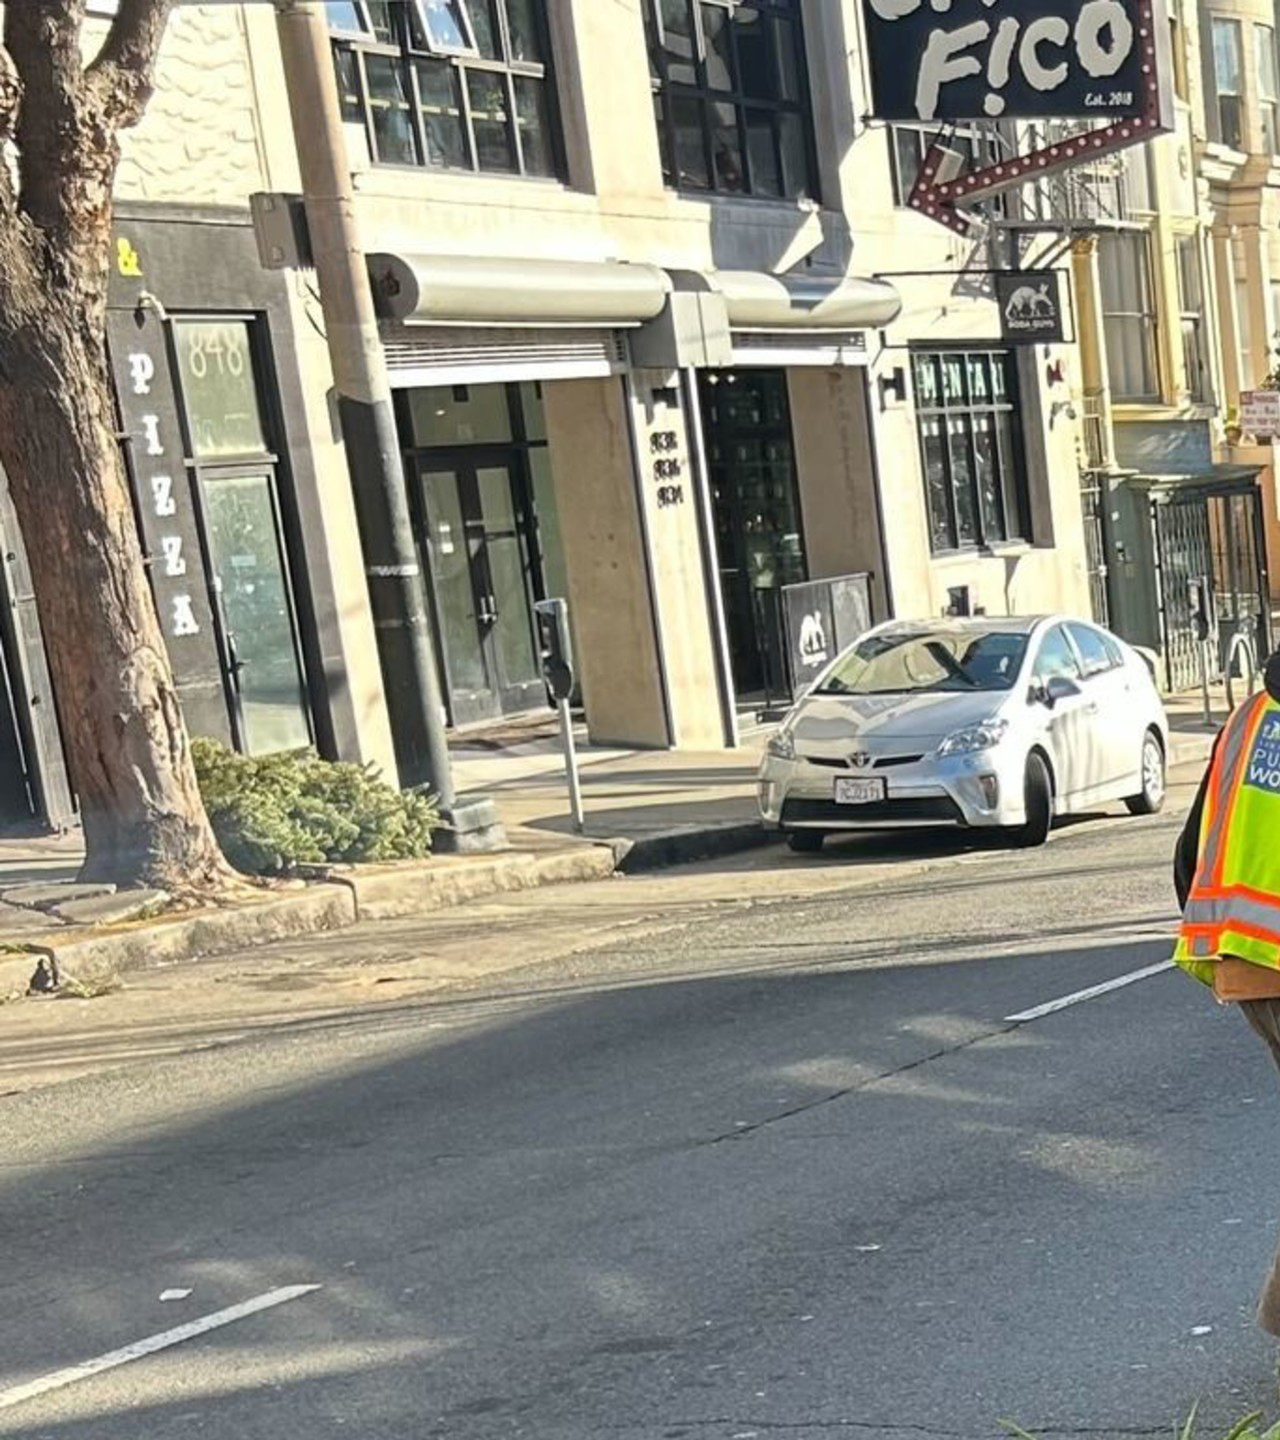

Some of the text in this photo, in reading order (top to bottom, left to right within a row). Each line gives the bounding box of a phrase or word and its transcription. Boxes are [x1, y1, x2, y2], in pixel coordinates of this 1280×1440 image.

[1108, 90, 1133, 106] 2018
[189, 328, 243, 378] 848
[128, 353, 200, 636] PIZZA
